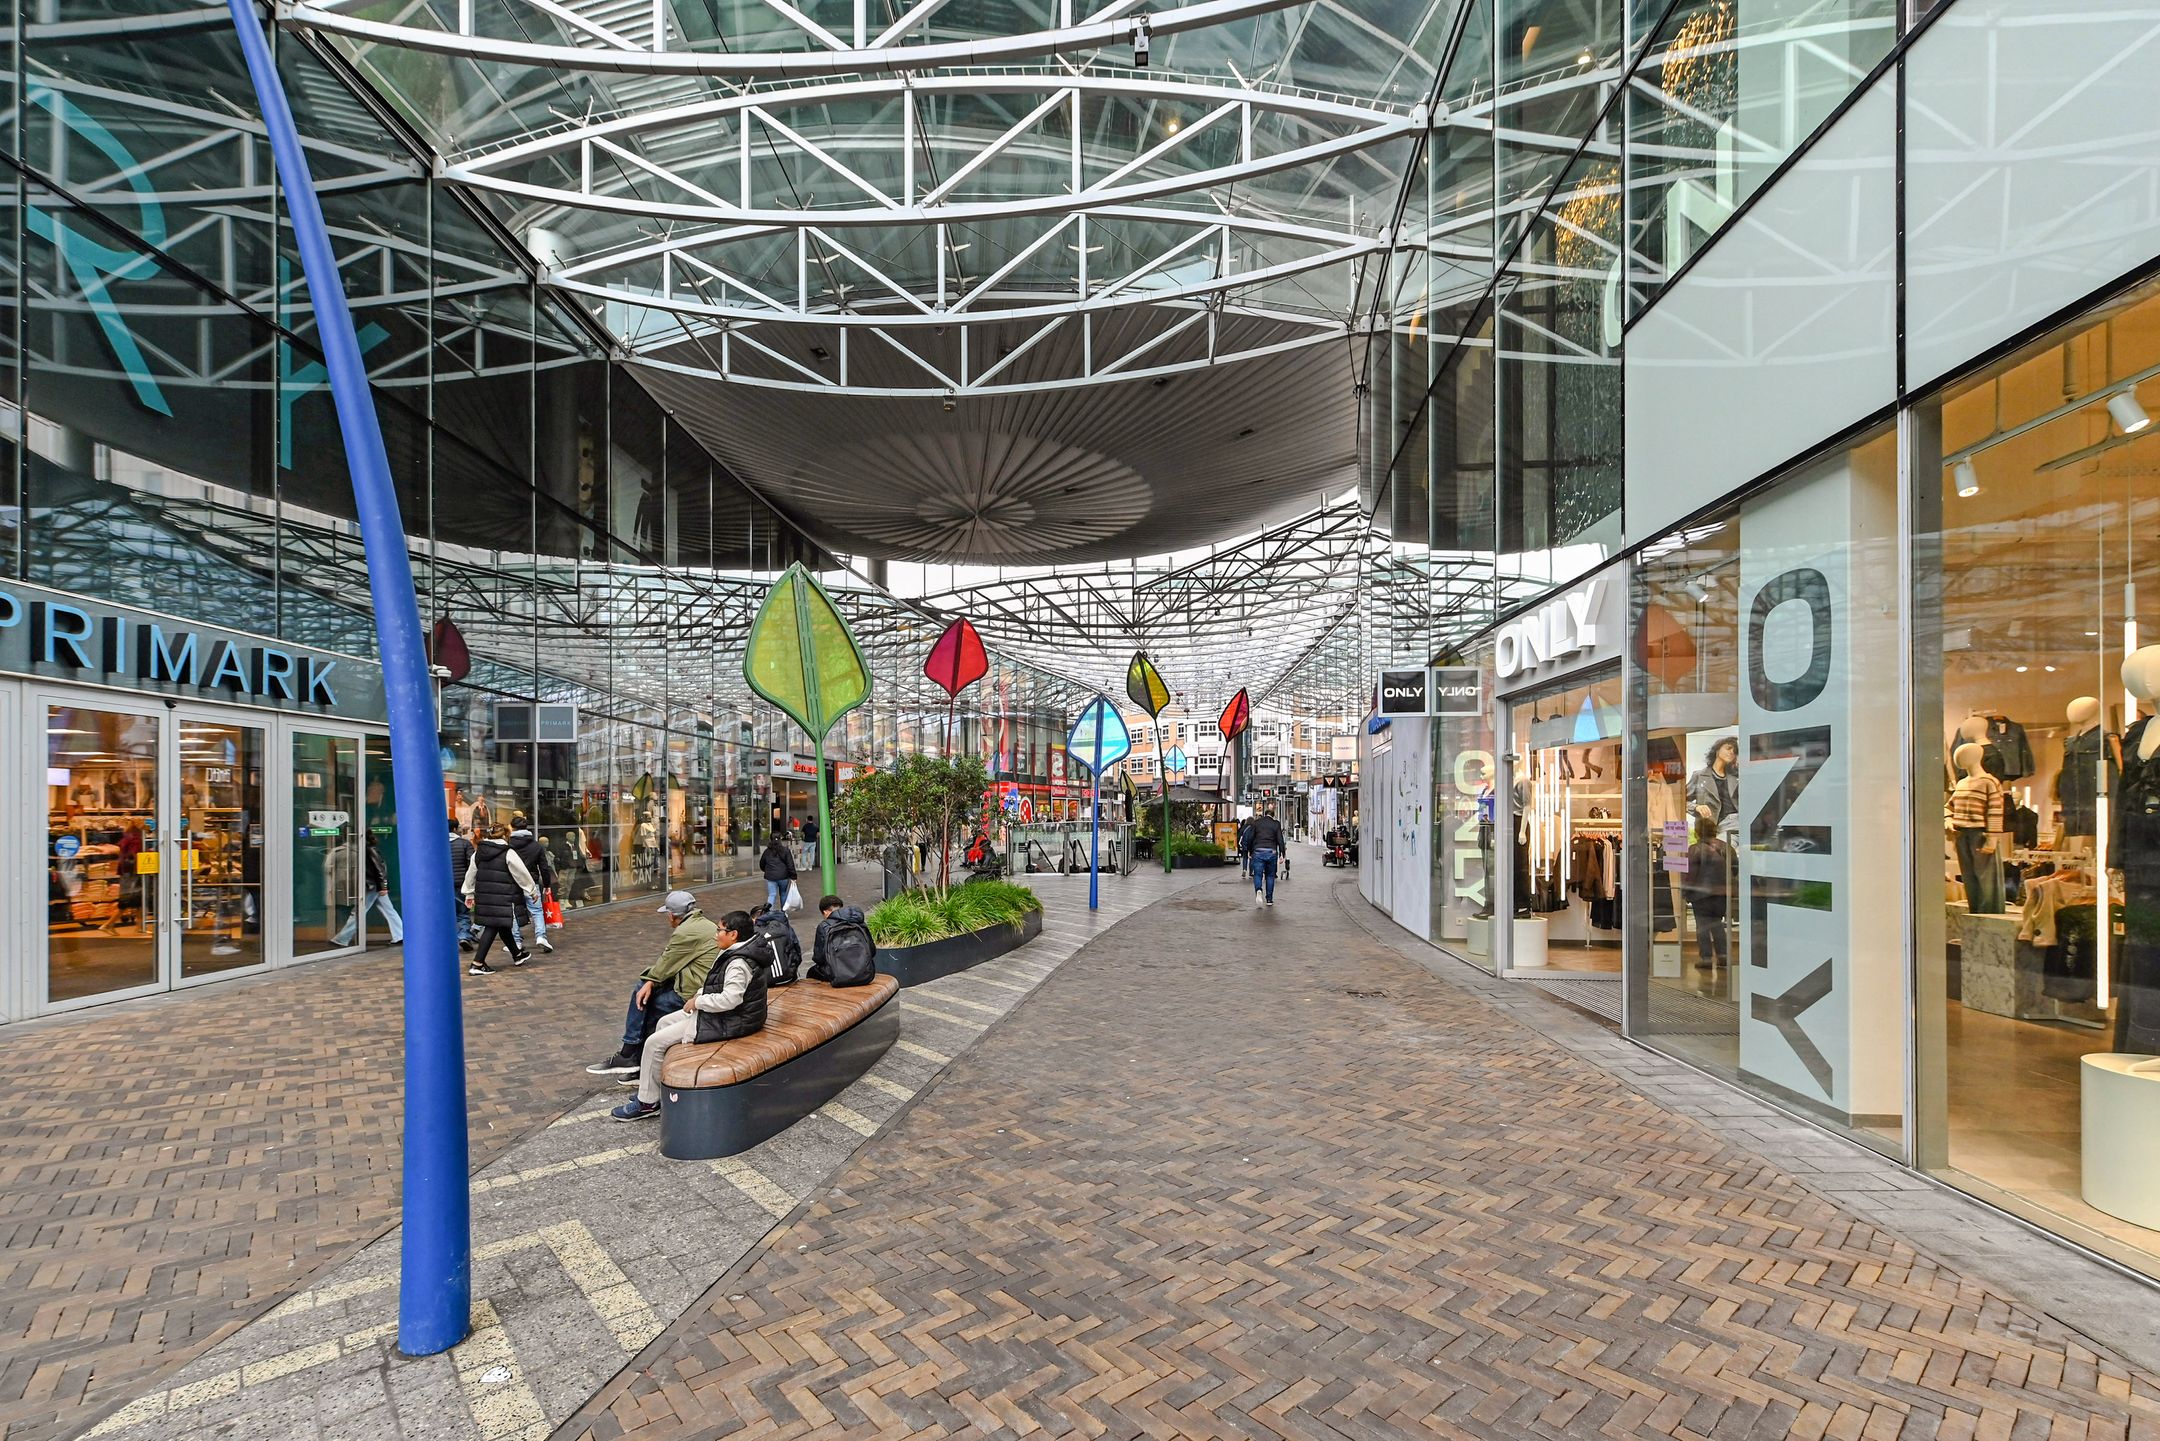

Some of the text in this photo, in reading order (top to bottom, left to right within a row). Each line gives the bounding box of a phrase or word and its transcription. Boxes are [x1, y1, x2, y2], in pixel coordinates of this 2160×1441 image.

[1495, 576, 1609, 679] ONLY
[1384, 687, 1424, 698] ONLY
[1453, 749, 1496, 908] ONLY
[1748, 567, 1834, 1101] ONLY
[624, 852, 652, 868] DENIM
[631, 867, 652, 885] CAN
